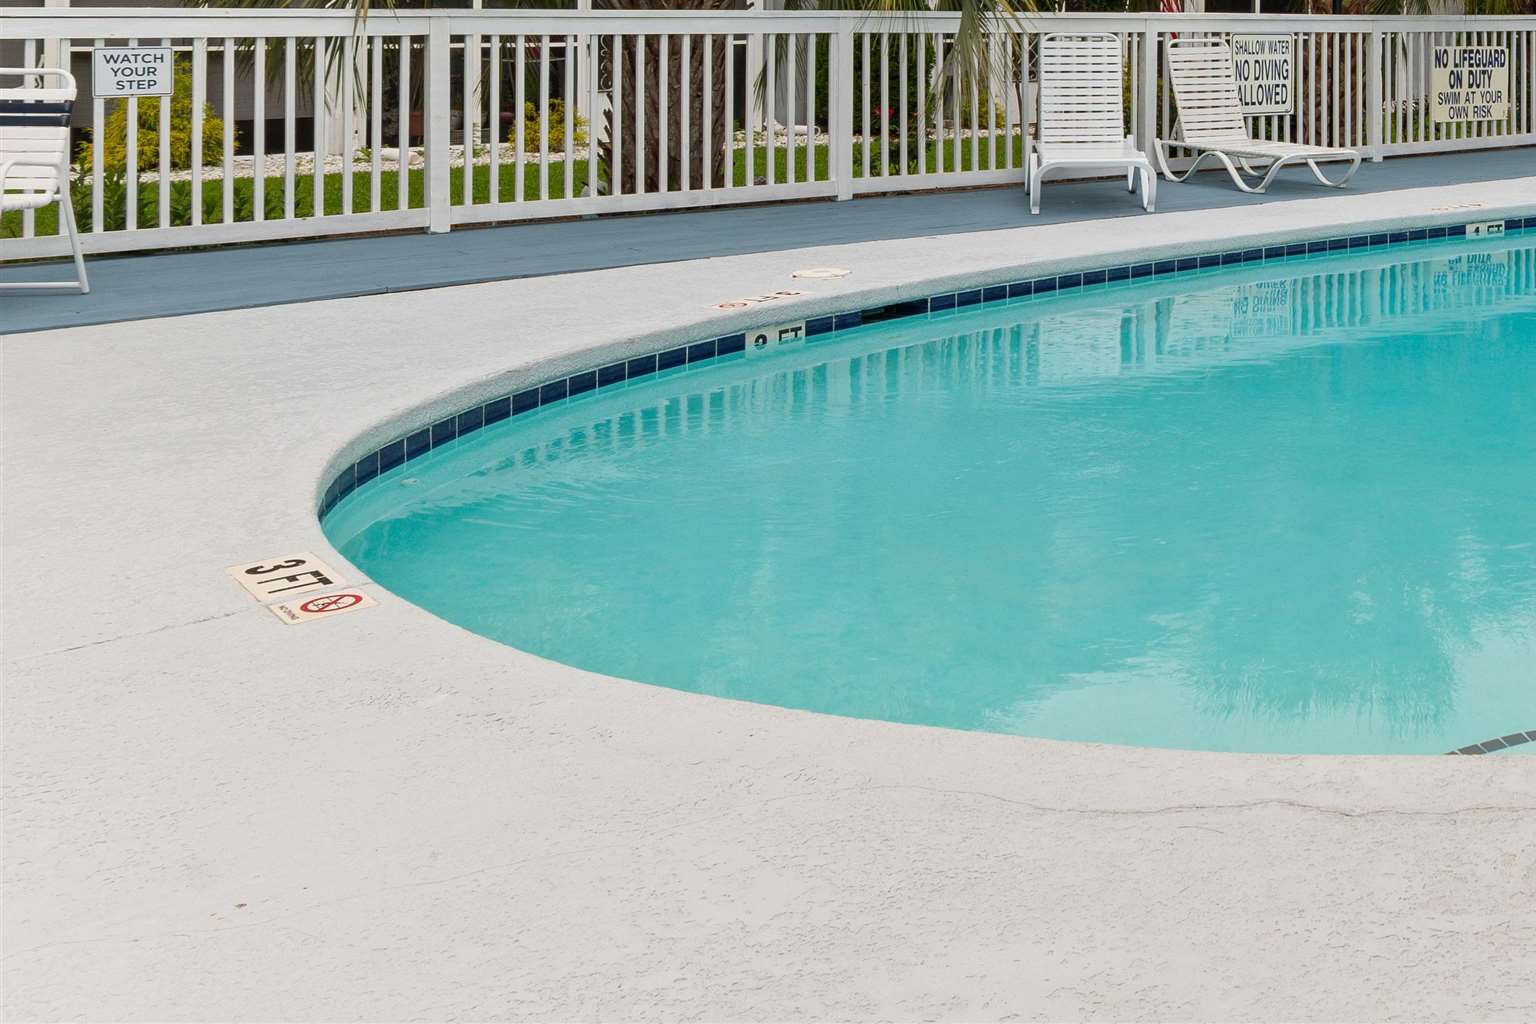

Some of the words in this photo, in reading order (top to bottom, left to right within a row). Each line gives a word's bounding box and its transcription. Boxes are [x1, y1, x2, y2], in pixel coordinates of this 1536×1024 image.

[1234, 39, 1266, 55] SHALLOW
[1267, 39, 1290, 55] WATER
[102, 53, 164, 64] WATCH
[1434, 49, 1449, 69] NO
[1453, 48, 1506, 68] LIFEGUARD
[110, 66, 157, 77] YOUR
[1235, 59, 1250, 82] NO
[1254, 59, 1289, 81] DIVING
[116, 79, 157, 90] STEP
[1448, 70, 1463, 90] ON
[1468, 69, 1493, 89] DUTY
[1237, 83, 1288, 107] ALLOWED
[1438, 91, 1460, 105] SWIM
[1464, 91, 1476, 105] AT
[1480, 90, 1503, 104] YOUR
[1448, 106, 1469, 120] OWN
[1473, 105, 1493, 119] RISK
[244, 559, 307, 575] 3
[257, 570, 334, 594] FT
